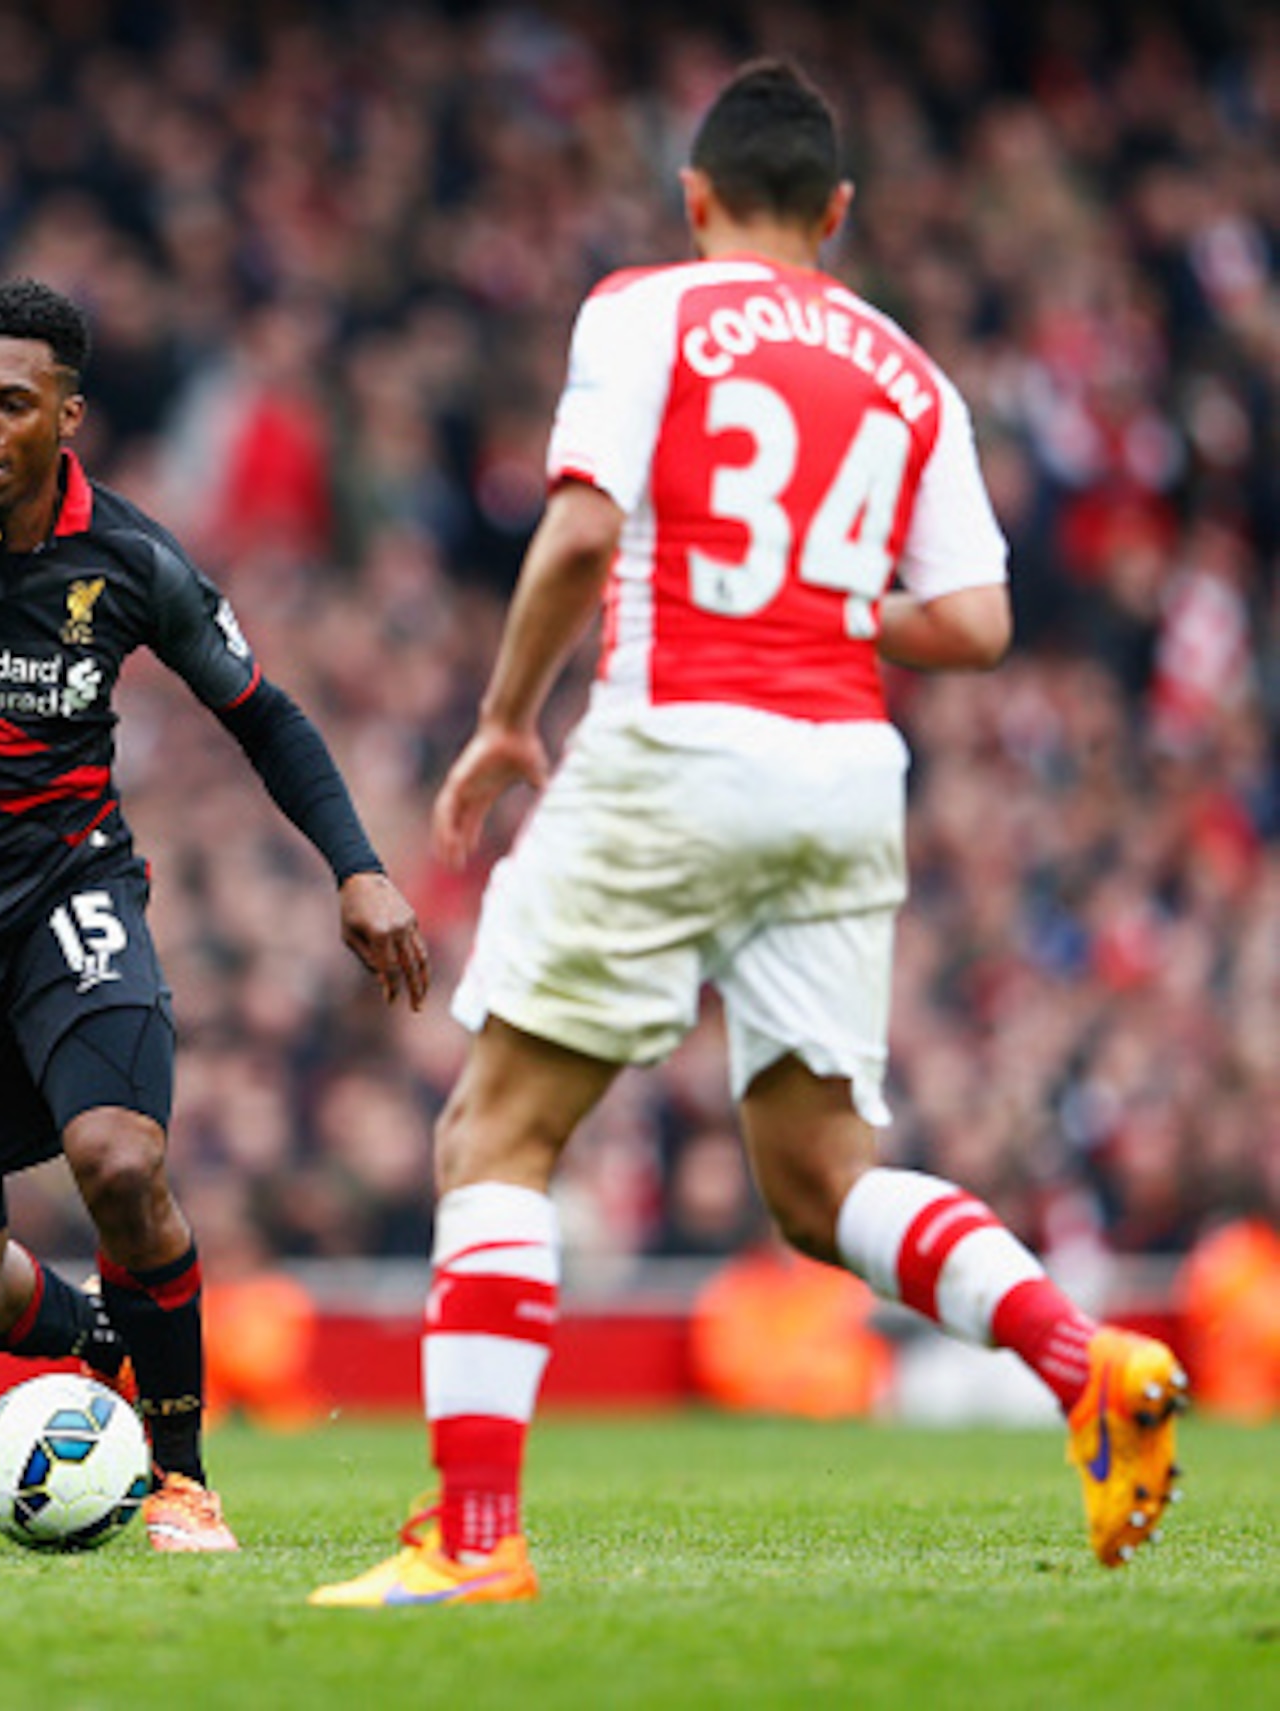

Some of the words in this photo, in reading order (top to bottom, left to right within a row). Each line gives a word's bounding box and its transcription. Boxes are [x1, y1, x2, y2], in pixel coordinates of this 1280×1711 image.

[683, 294, 933, 423] COQUELIN
[687, 378, 912, 640] 34
[48, 891, 128, 972] 15
